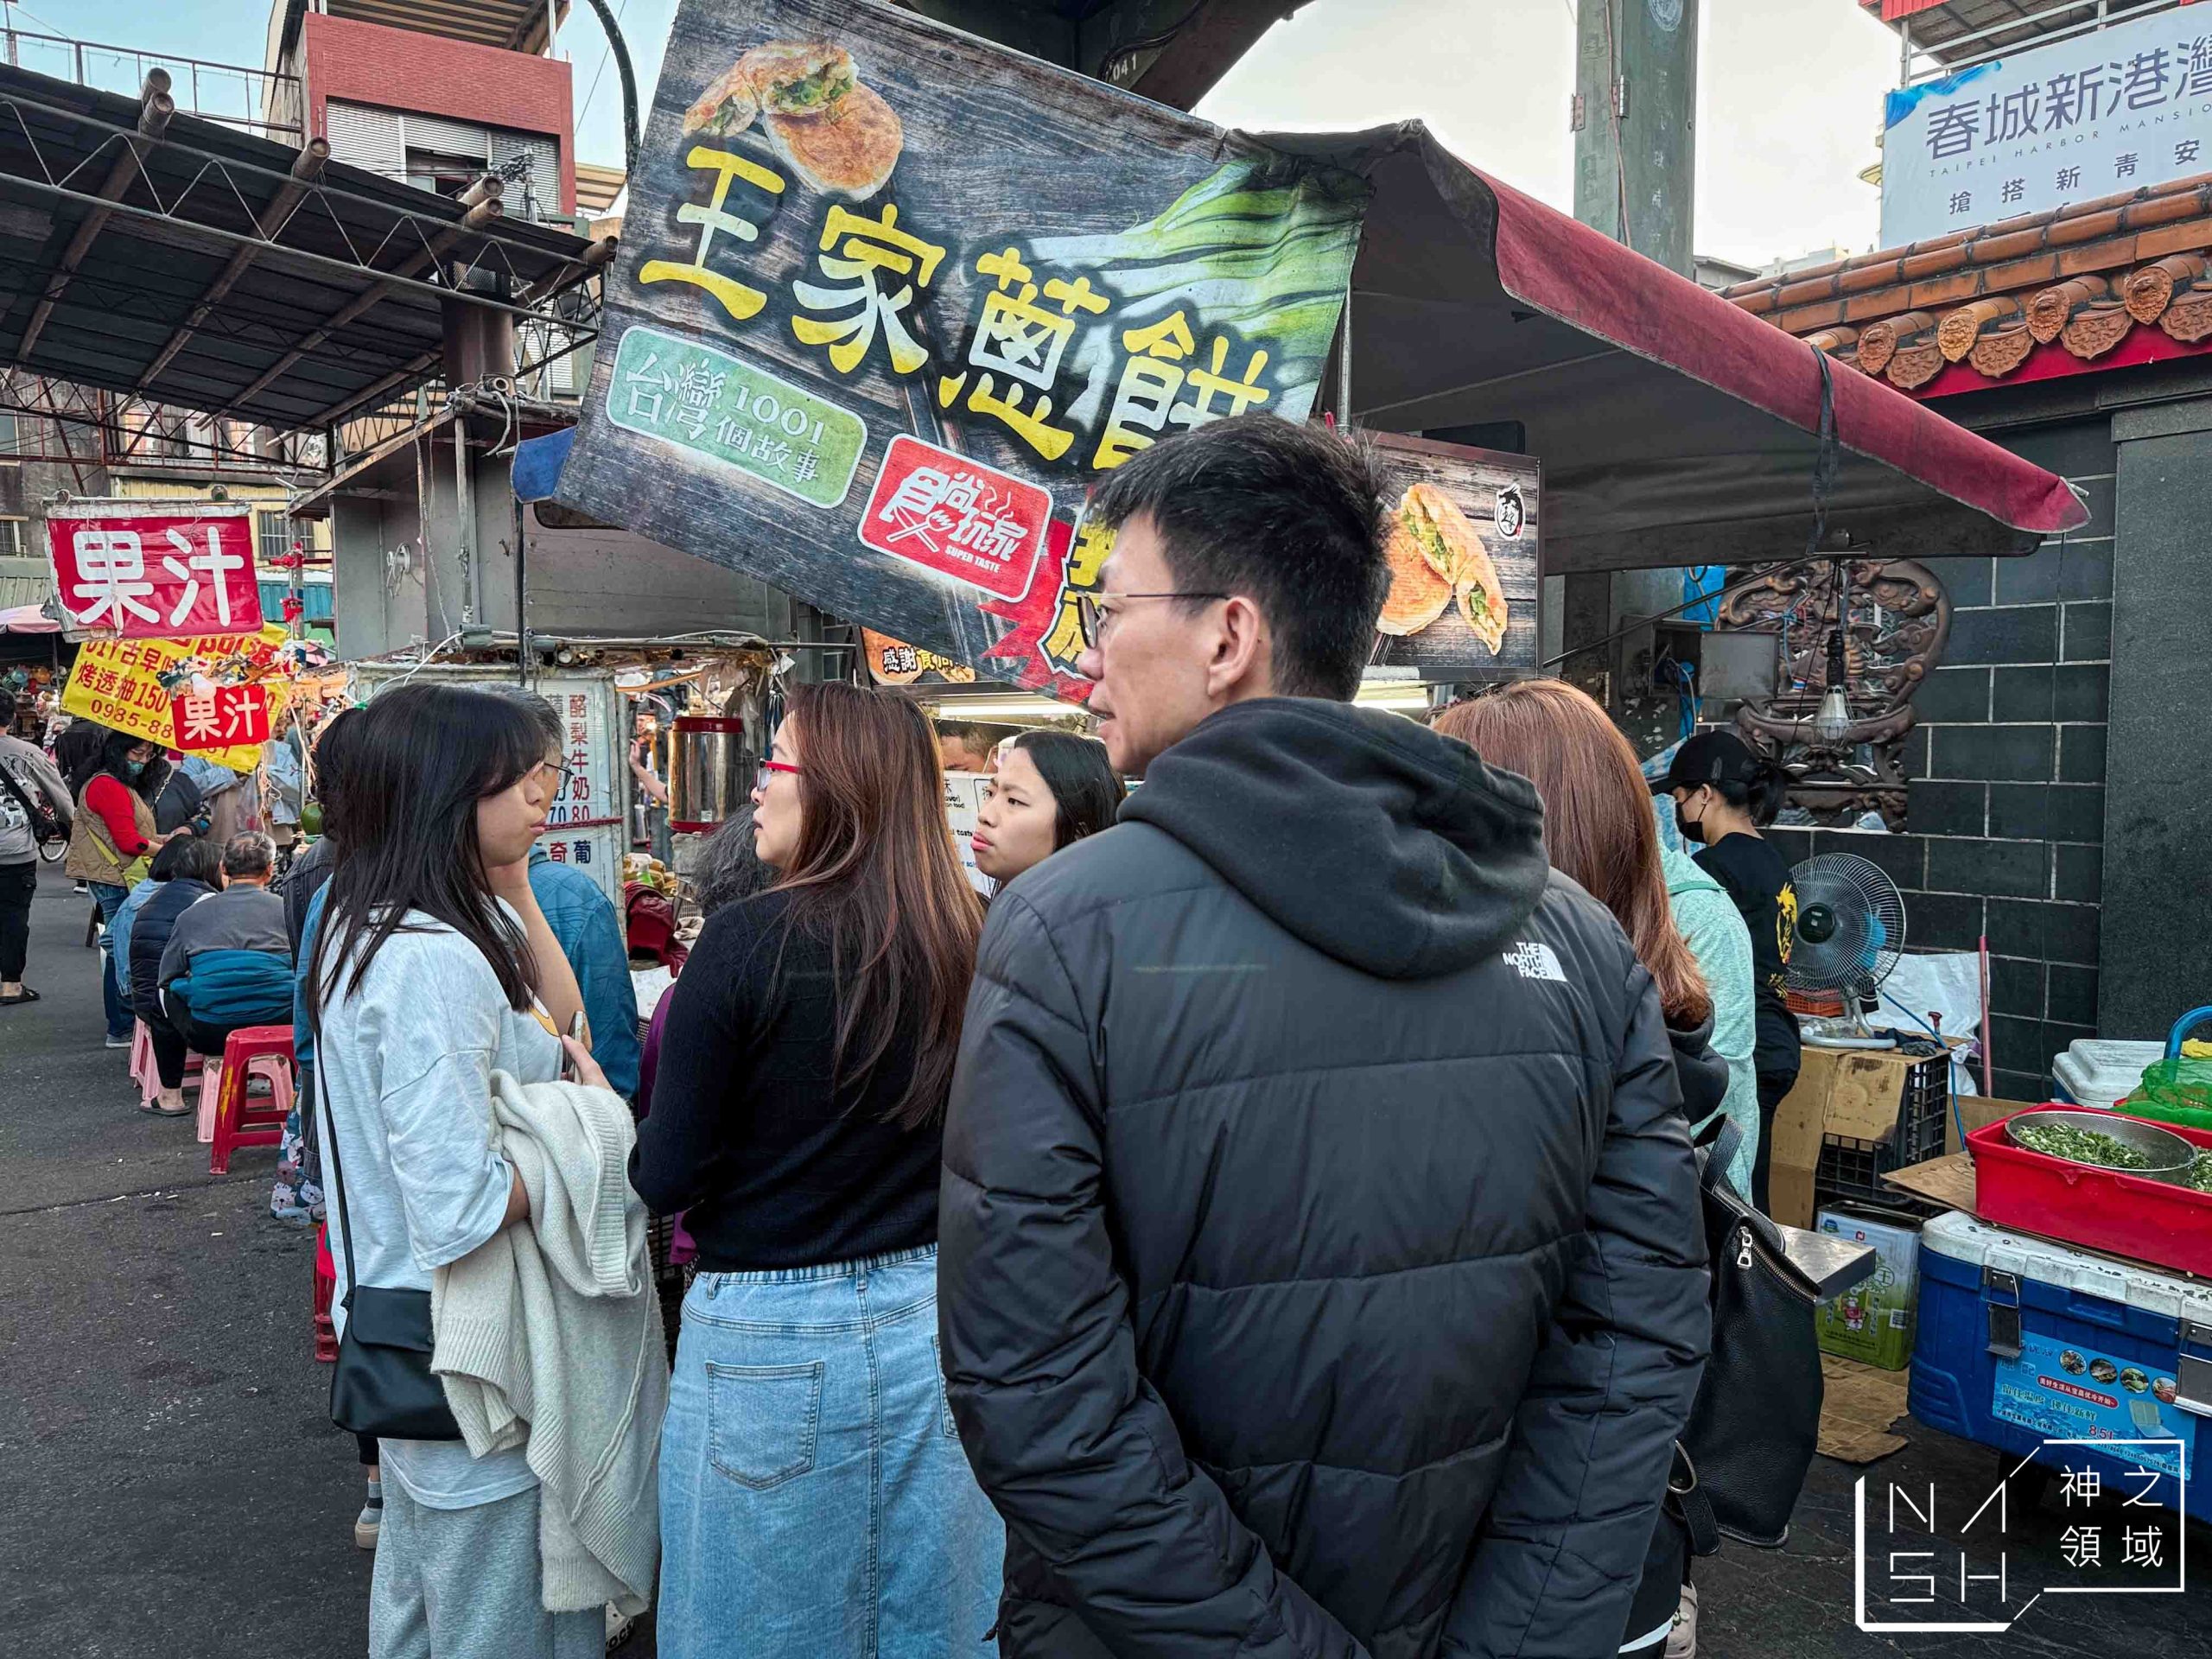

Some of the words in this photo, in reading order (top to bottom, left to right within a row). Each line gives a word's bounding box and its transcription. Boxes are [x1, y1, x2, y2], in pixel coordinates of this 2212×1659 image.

[1930, 156, 1996, 177] TAIPEI
[2015, 130, 2099, 157] HARBOR
[1949, 139, 2200, 215] 搶搭新青安
[626, 353, 727, 441] 台灣
[733, 384, 826, 447] 1001
[715, 414, 820, 484] 個故事
[72, 525, 245, 627] 果汁
[945, 544, 972, 563] SUPER
[975, 556, 1001, 574] TASTE
[184, 690, 259, 742] 果汁
[569, 694, 590, 801] 酪梨牛奶
[574, 840, 591, 864] 葡
[1503, 952, 1542, 968] NORTH
[1516, 942, 1539, 955] THE
[1518, 967, 1548, 979] FACE
